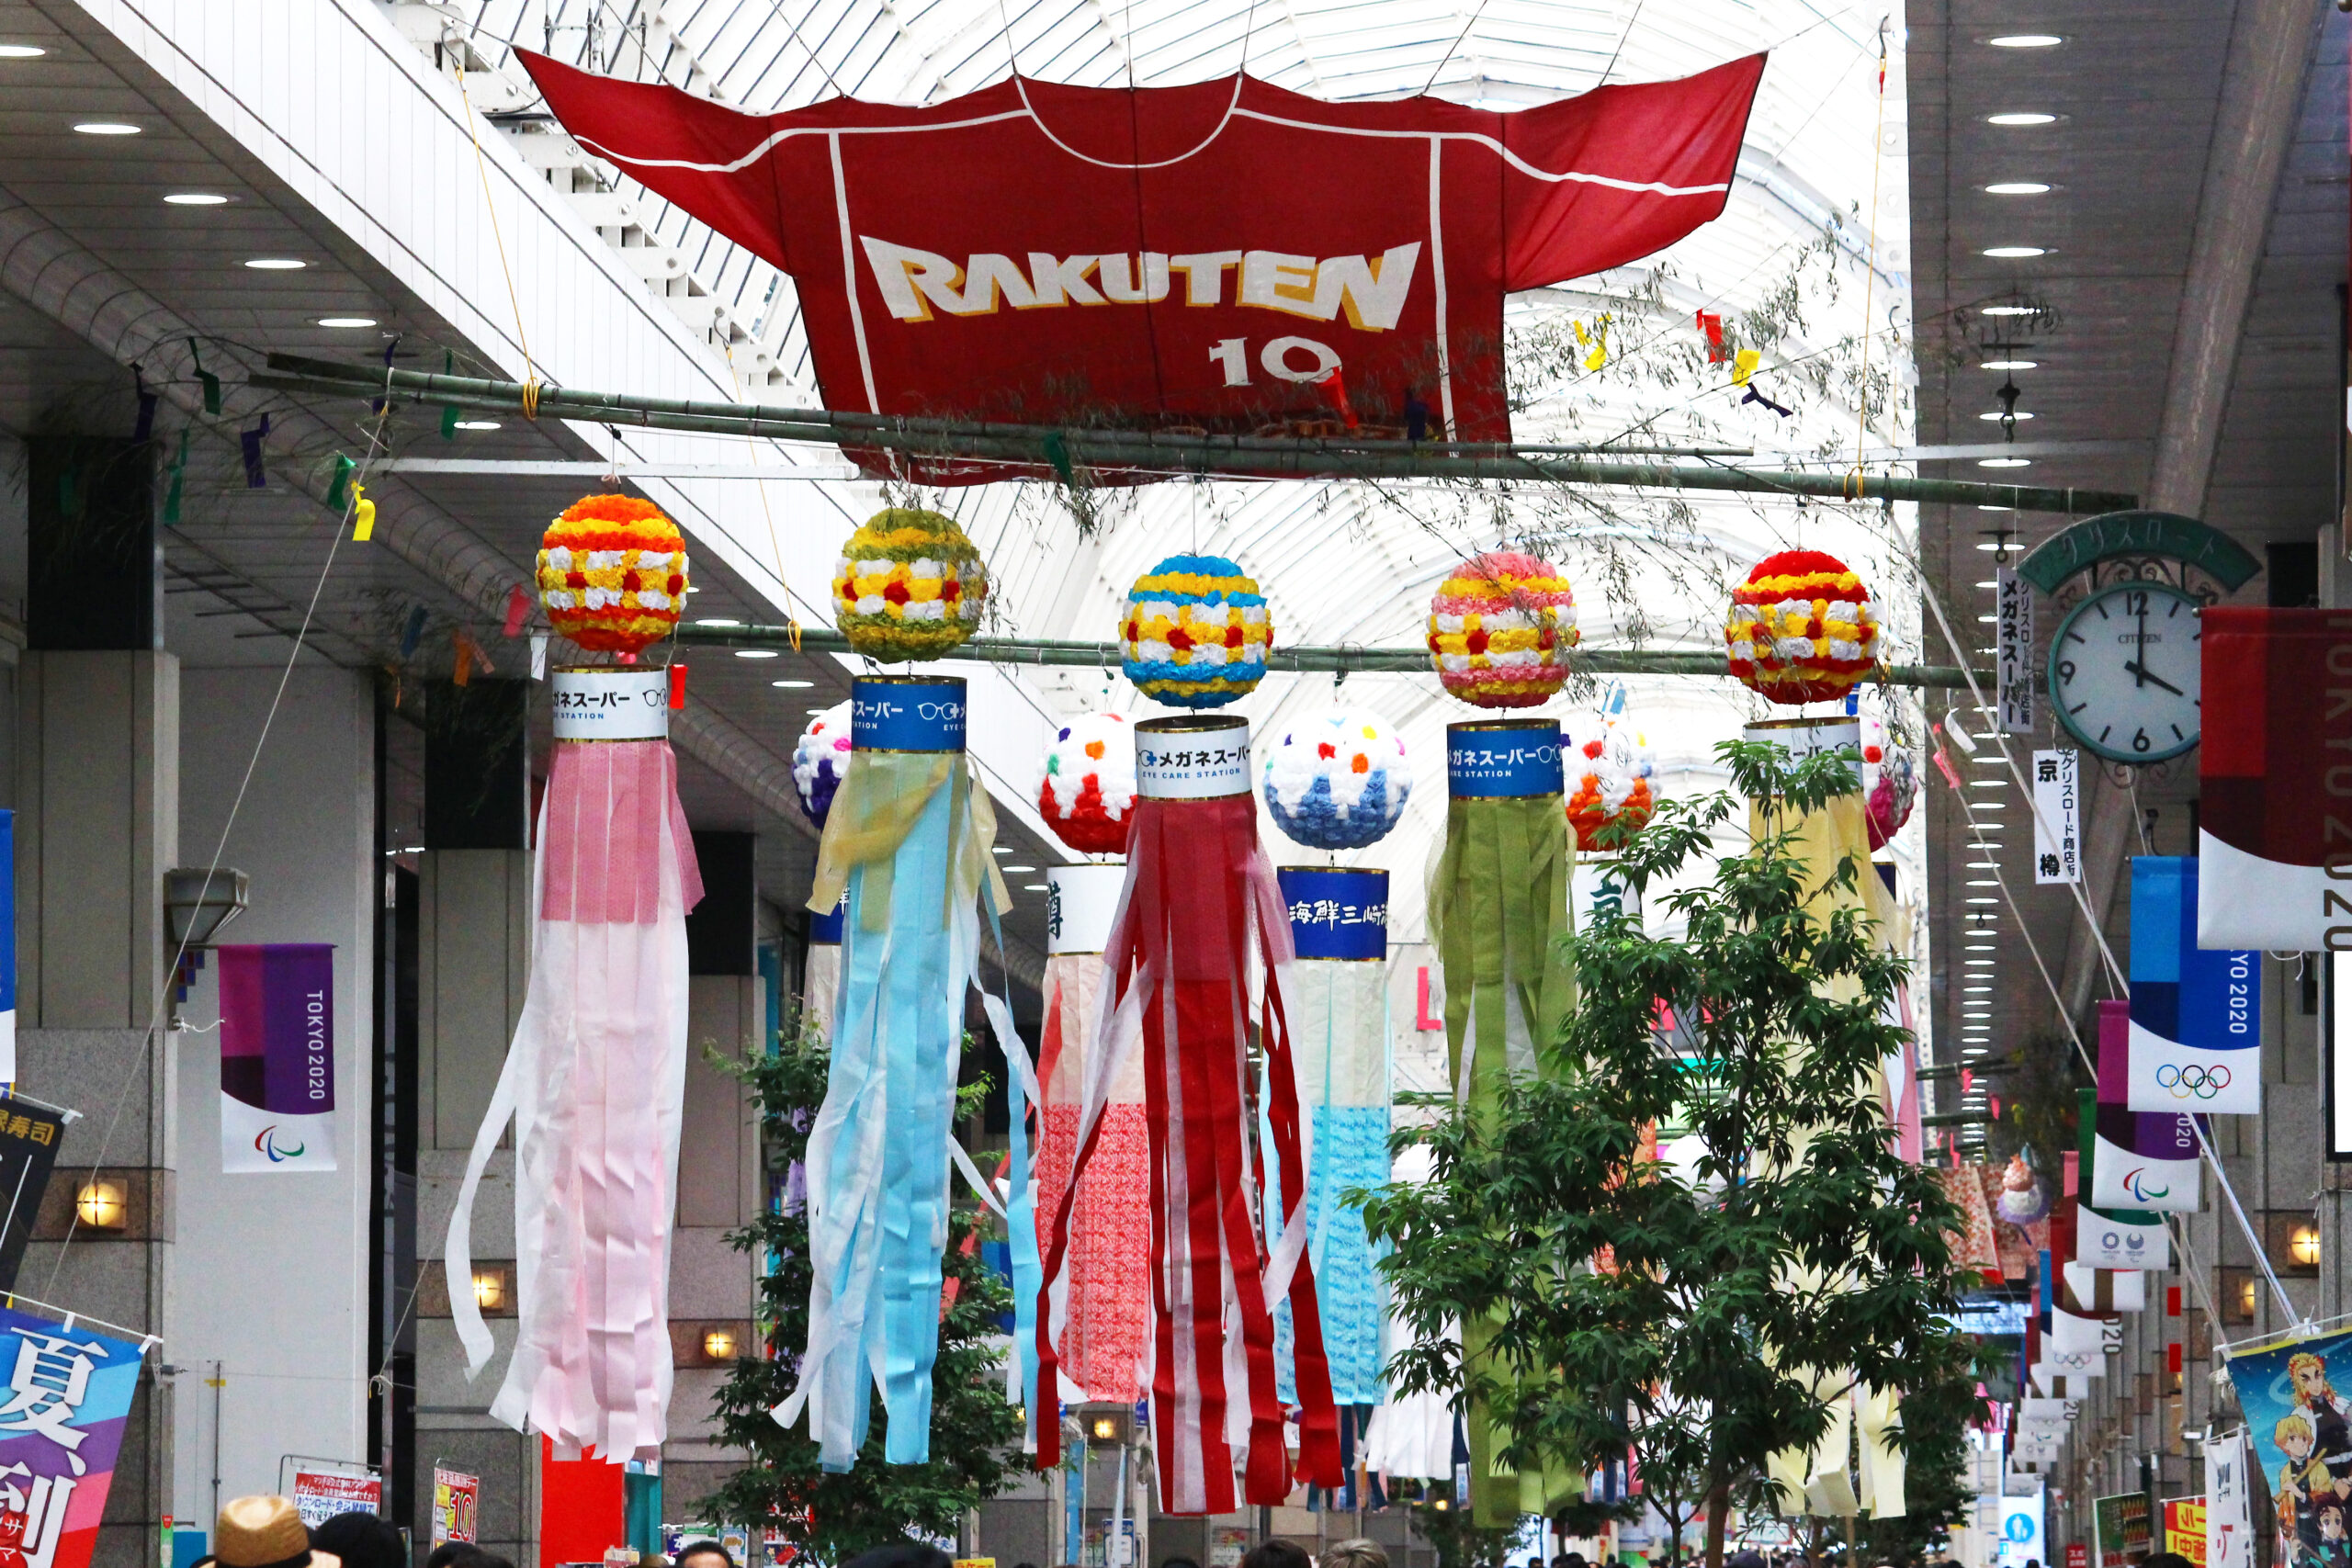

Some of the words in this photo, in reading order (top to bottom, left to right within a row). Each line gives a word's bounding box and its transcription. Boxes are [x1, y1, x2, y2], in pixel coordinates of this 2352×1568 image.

[859, 235, 1421, 332] RAKUTEN
[1209, 335, 1341, 387] 10
[2126, 592, 2149, 615] 12
[2118, 633, 2162, 644] CITZEN
[2058, 661, 2075, 686] 9
[2132, 728, 2151, 753] 6
[1196, 768, 1241, 778] STATION
[1465, 770, 1512, 778] STATION
[306, 989, 324, 1051] TOKYO
[2229, 984, 2248, 1034] 2020
[308, 1055, 325, 1100] 2020
[448, 1492, 473, 1541] 10
